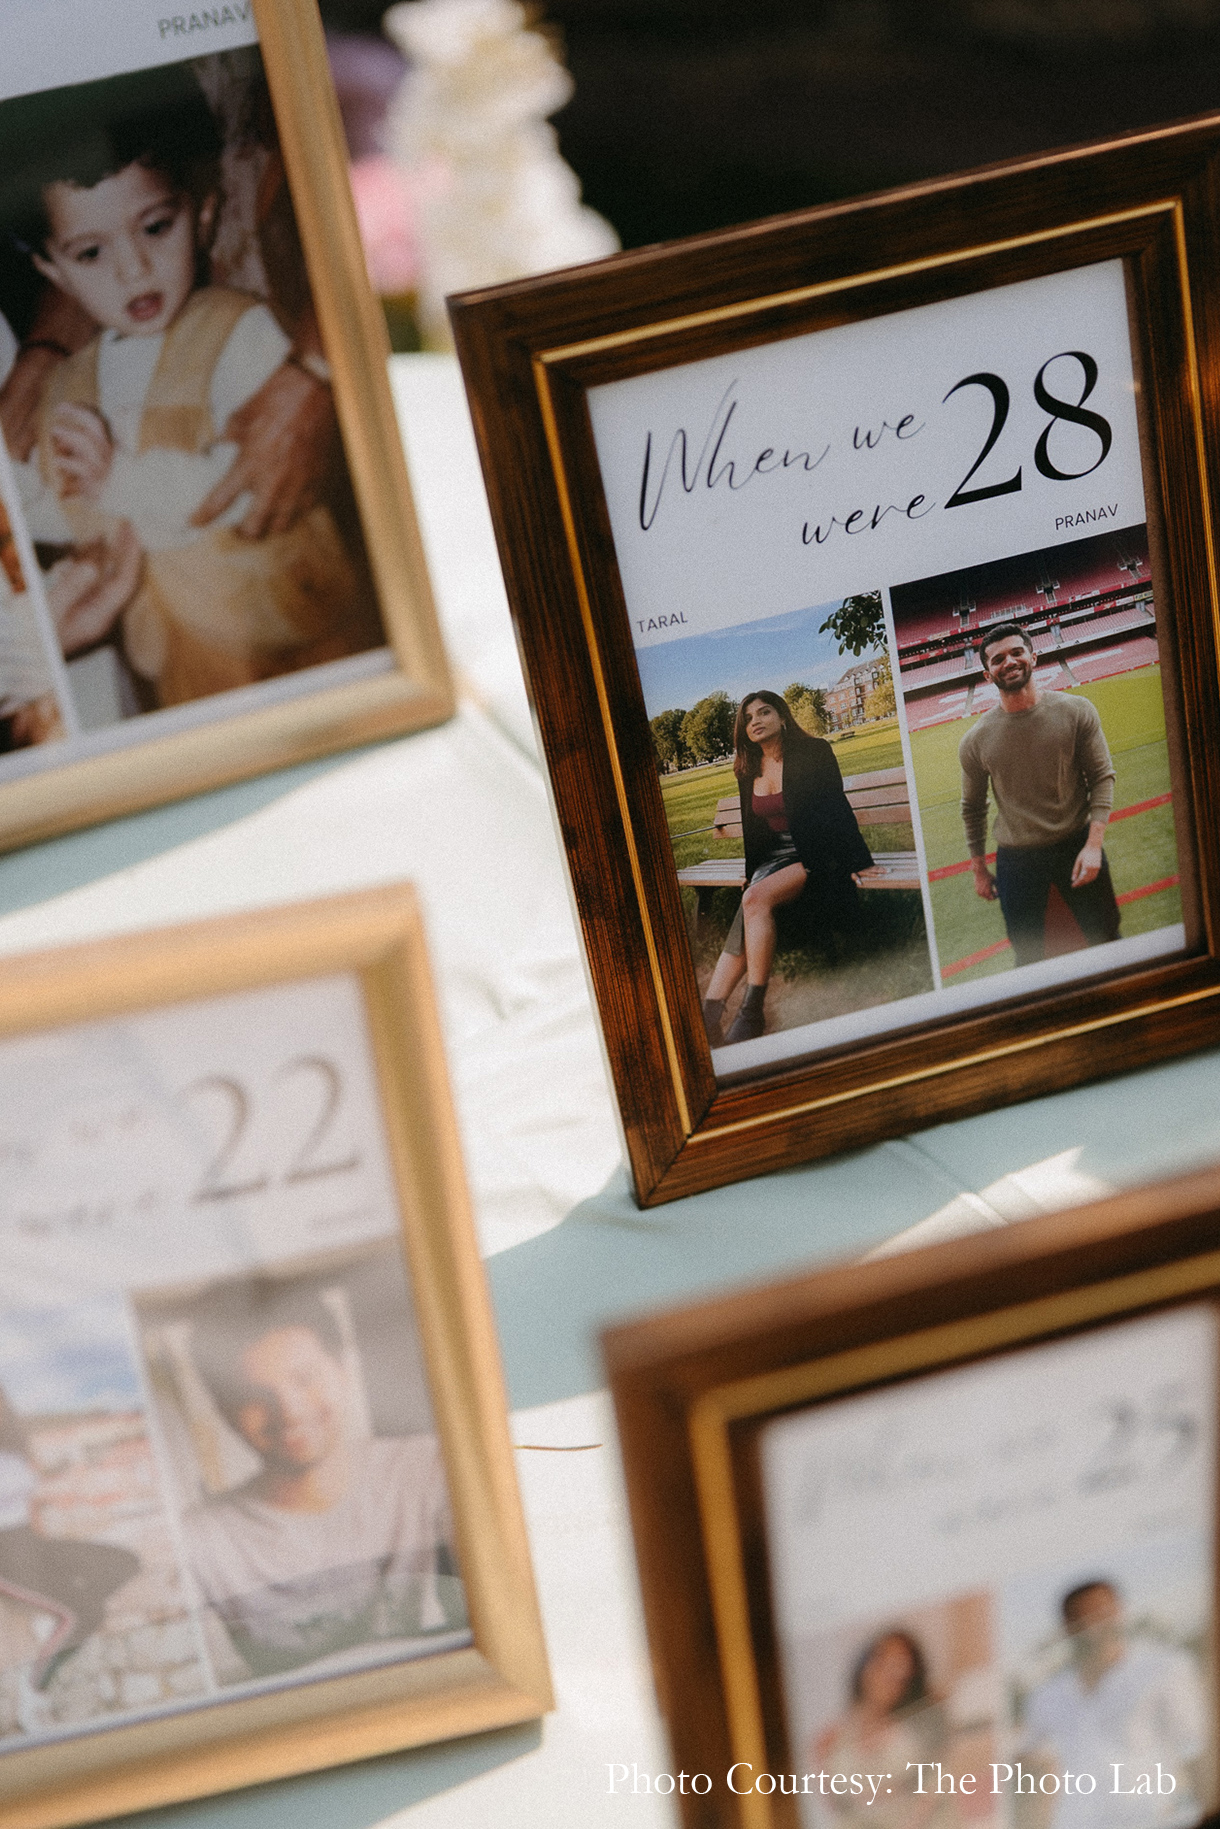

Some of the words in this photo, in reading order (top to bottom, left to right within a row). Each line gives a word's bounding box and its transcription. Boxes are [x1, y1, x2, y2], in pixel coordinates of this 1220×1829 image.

[157, 0, 251, 39] PRANAV
[640, 378, 830, 531] When
[853, 414, 926, 450] we
[802, 494, 936, 545] were
[942, 351, 1112, 509] 28
[1054, 503, 1119, 531] PRANAV
[636, 611, 688, 633] TARAL
[181, 1053, 360, 1205] 22
